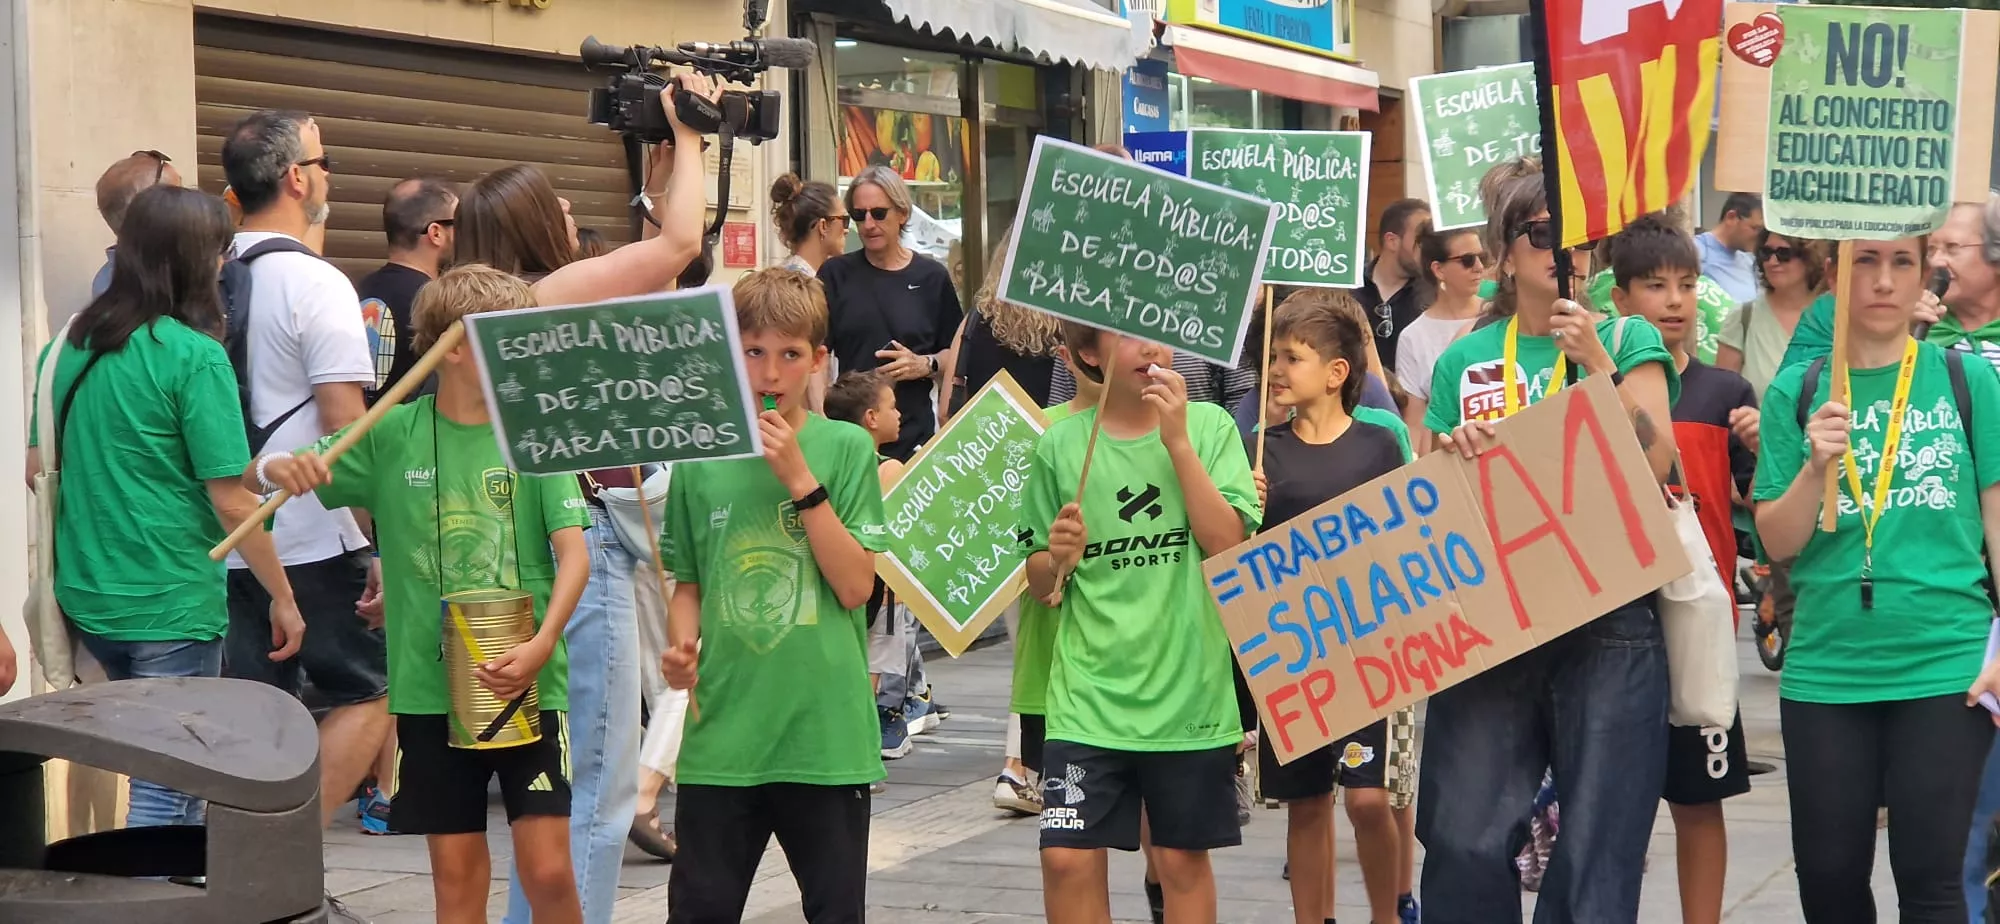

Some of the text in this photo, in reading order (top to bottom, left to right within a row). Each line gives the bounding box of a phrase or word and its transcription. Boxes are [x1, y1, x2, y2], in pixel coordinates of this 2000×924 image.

[1825, 21, 1909, 88] NO!
[1435, 78, 1526, 118] ESCUELA
[1779, 94, 1950, 131] AL CONCIERTO
[1202, 143, 1358, 182] ESCUELA PÚBLICA:
[1463, 140, 1500, 167] DE
[1777, 131, 1948, 170] EDUCATIVO EN
[1769, 169, 1945, 208] BACHILLERATO
[1051, 169, 1257, 251] ESCUELA PÚBLICA:
[1060, 230, 1218, 295] DE TOD@S
[1268, 246, 1348, 277] TOD@S
[1029, 272, 1224, 348] PARA TOD@S
[496, 316, 724, 361] ESCUELA PÚBLICA:
[535, 375, 709, 415] DE TOD@S
[530, 422, 741, 465] PARA TOD@S
[489, 480, 510, 494] 50
[888, 408, 1018, 540] ESCUELA PÚBLICA:
[935, 524, 965, 562] DE
[1110, 551, 1182, 571] SPORTS
[954, 543, 1010, 606] PARA
[1266, 669, 1336, 753] FP
